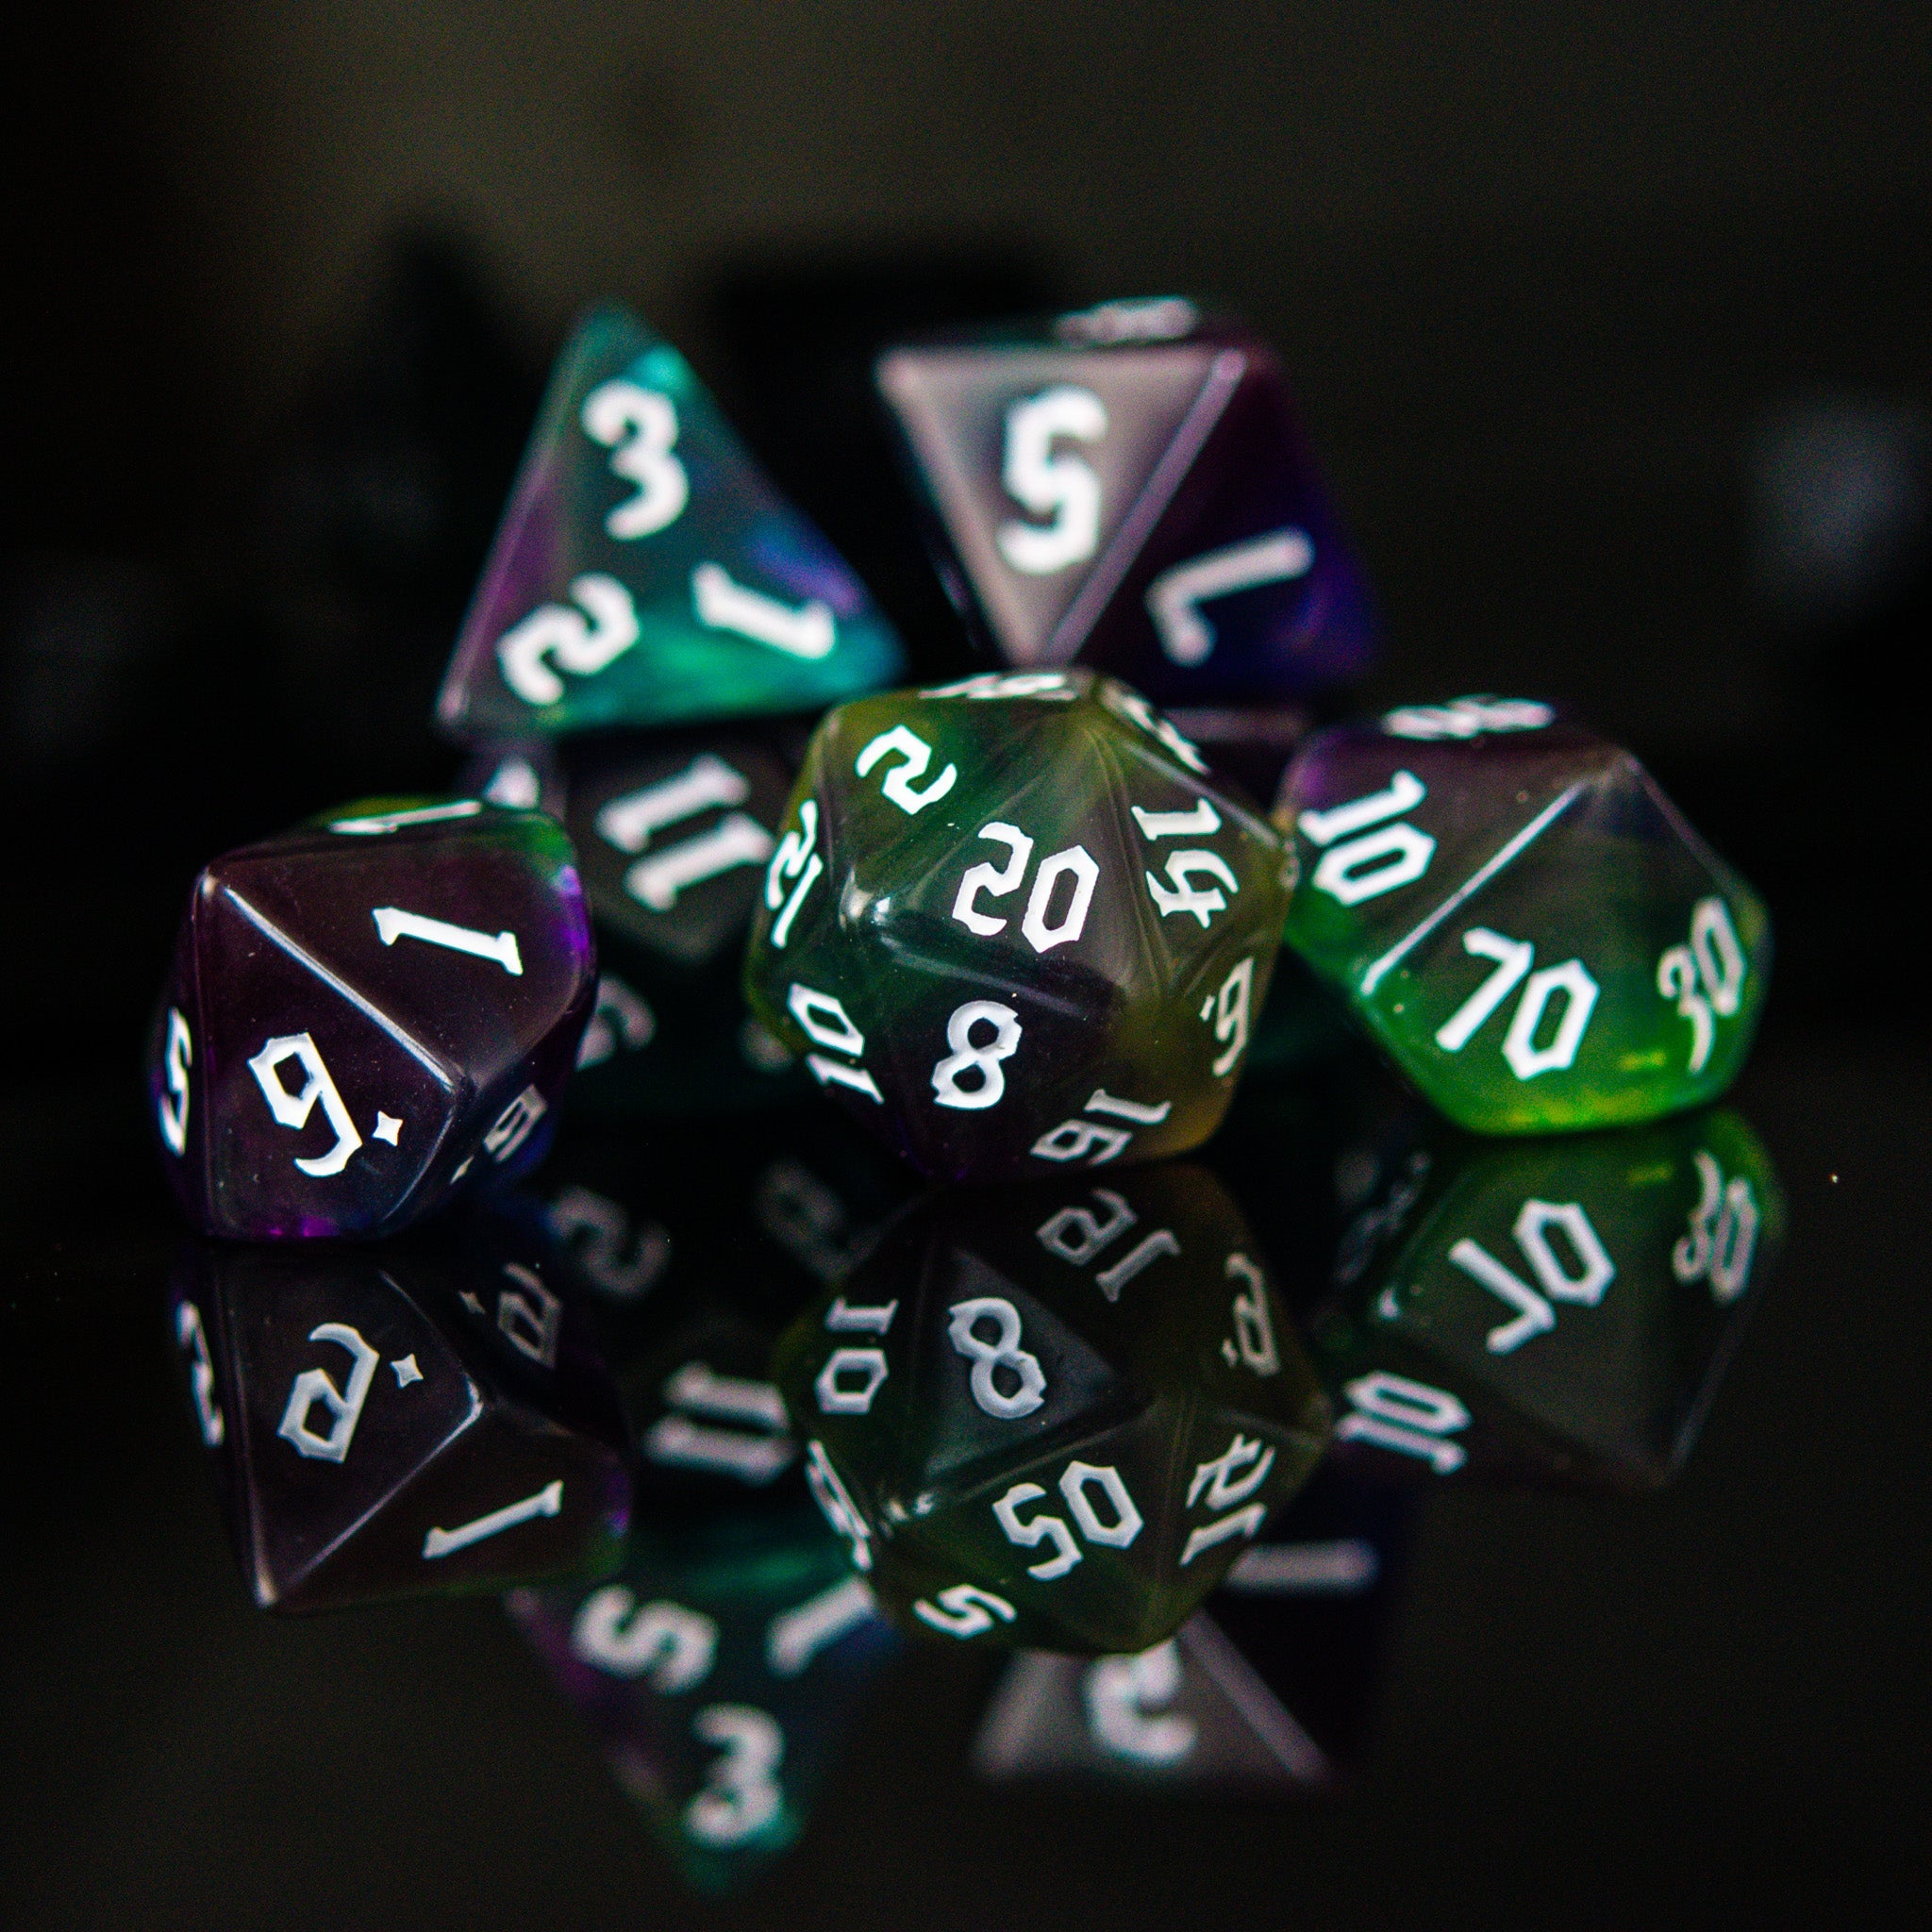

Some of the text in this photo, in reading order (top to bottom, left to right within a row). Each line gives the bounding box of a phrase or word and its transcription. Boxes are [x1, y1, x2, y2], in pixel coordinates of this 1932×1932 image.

[584, 383, 687, 537] 3
[1000, 386, 1108, 575] 5
[498, 577, 639, 704] 2
[691, 563, 836, 659] 1
[1147, 529, 1314, 664] 7
[596, 756, 774, 911] 11
[858, 726, 957, 814] 2
[952, 822, 1099, 953] 20
[1132, 799, 1238, 927] 14
[1299, 773, 1433, 904] 10
[374, 908, 523, 974] 1
[1437, 929, 1596, 1079] 70
[1657, 899, 1742, 1071] 30
[791, 984, 882, 1102] 10
[932, 1001, 1022, 1108] 8
